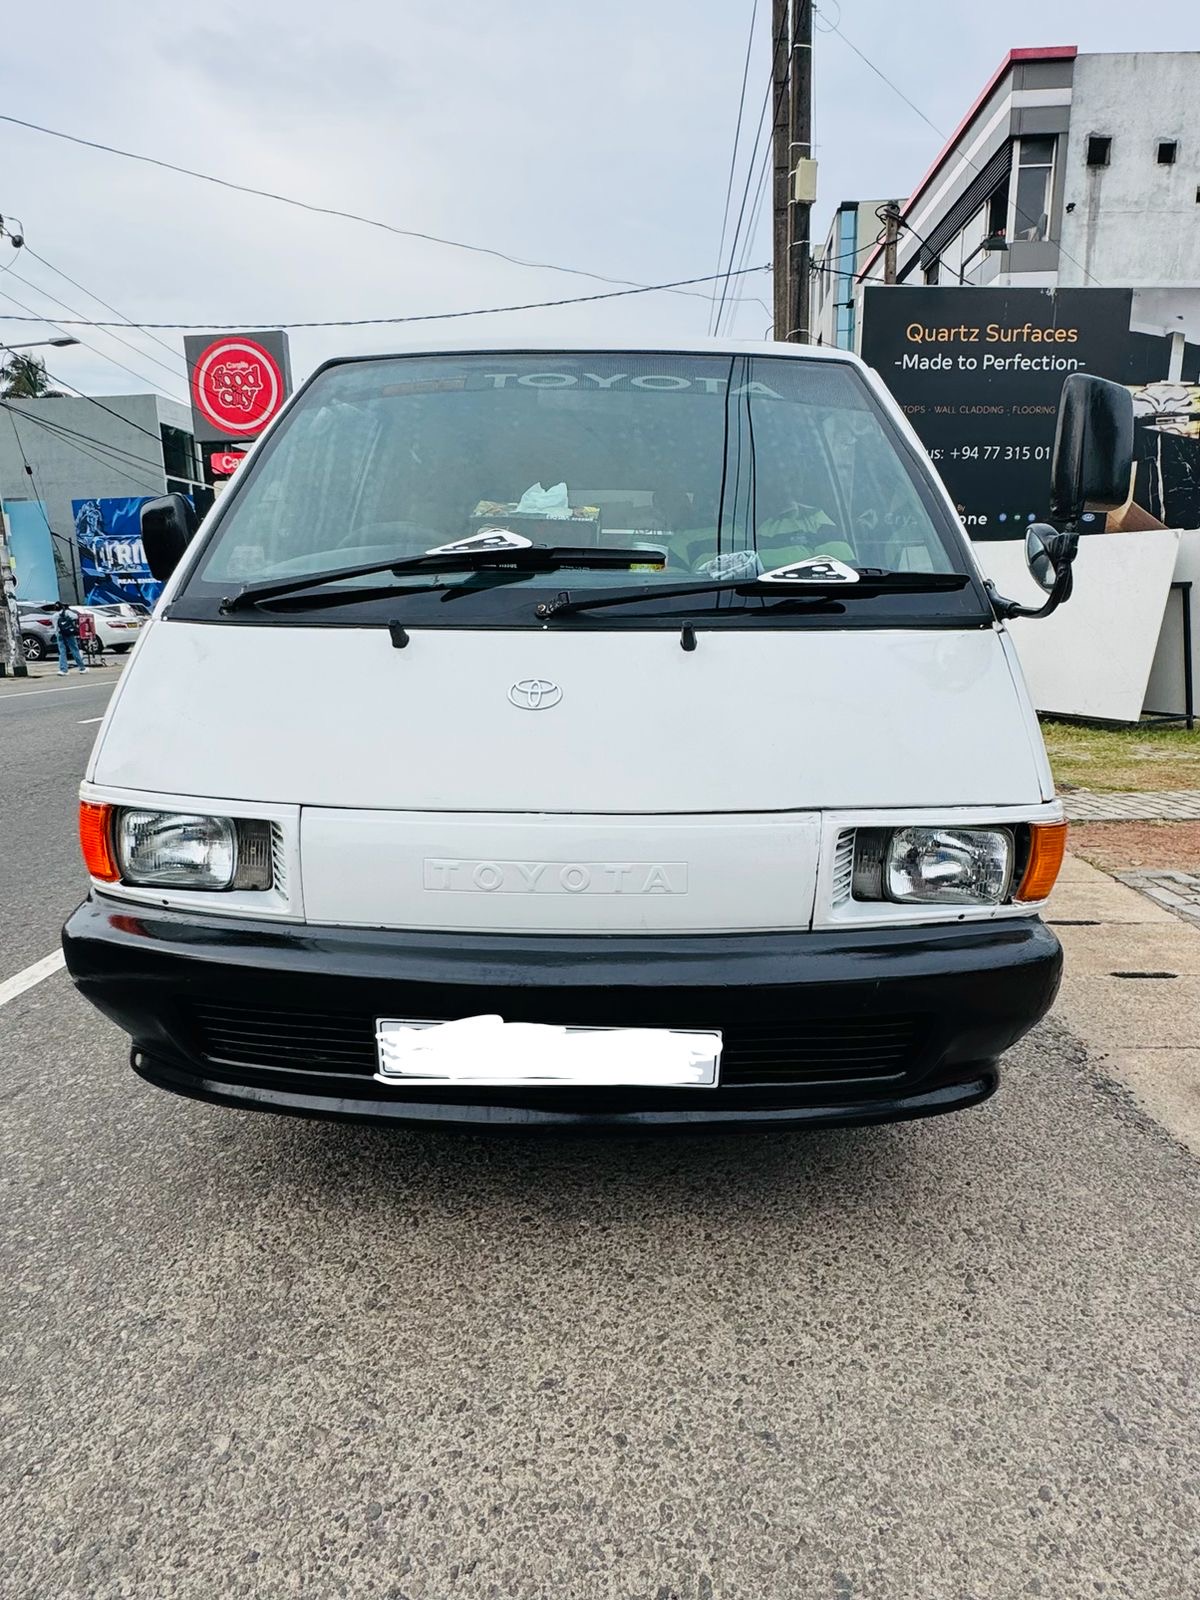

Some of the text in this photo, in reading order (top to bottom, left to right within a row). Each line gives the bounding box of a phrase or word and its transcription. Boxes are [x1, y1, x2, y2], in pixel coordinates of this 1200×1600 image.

[906, 323, 1078, 344] Quartz Surfaces
[895, 353, 1086, 371] -Made to Perfection-
[211, 363, 264, 392] food
[484, 372, 784, 400] TOYOTA
[903, 405, 1056, 415] TOPS WALL CLADDING FLOORING
[950, 446, 979, 460] +94
[984, 446, 1000, 460] 77
[1004, 446, 1031, 460] 315
[959, 515, 988, 526] one
[433, 861, 672, 893] TOYOTA
